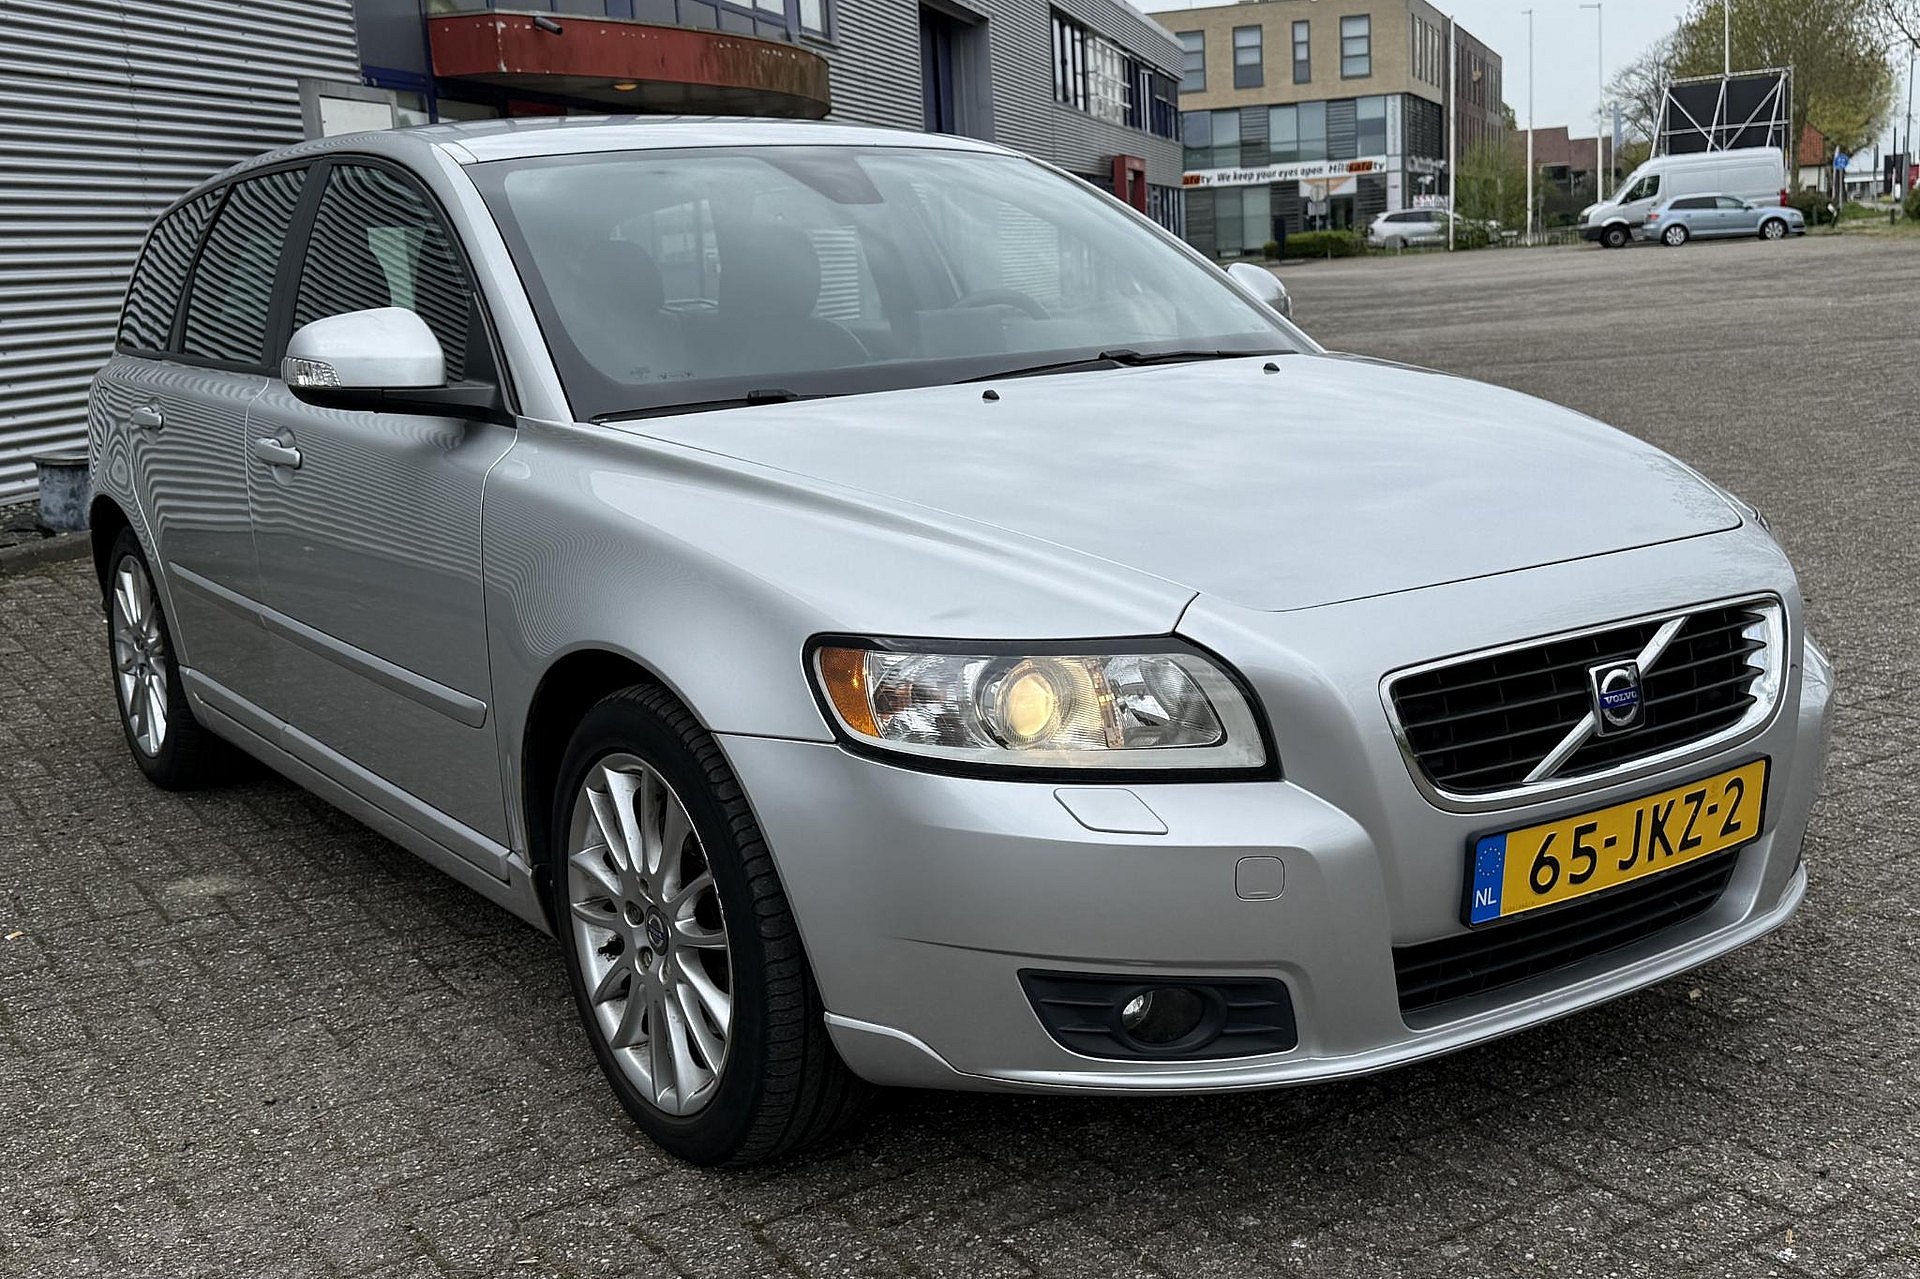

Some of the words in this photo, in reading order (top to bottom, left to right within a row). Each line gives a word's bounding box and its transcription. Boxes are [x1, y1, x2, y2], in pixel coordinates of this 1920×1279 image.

[1217, 172, 1231, 182] We
[1233, 171, 1254, 181] keep
[1256, 169, 1276, 182] your
[1278, 168, 1298, 180] eyes
[1300, 166, 1323, 177] open
[1604, 690, 1638, 704] VOLVO
[1529, 777, 1745, 895] 65-JKZ-2
[1474, 887, 1497, 909] NL
